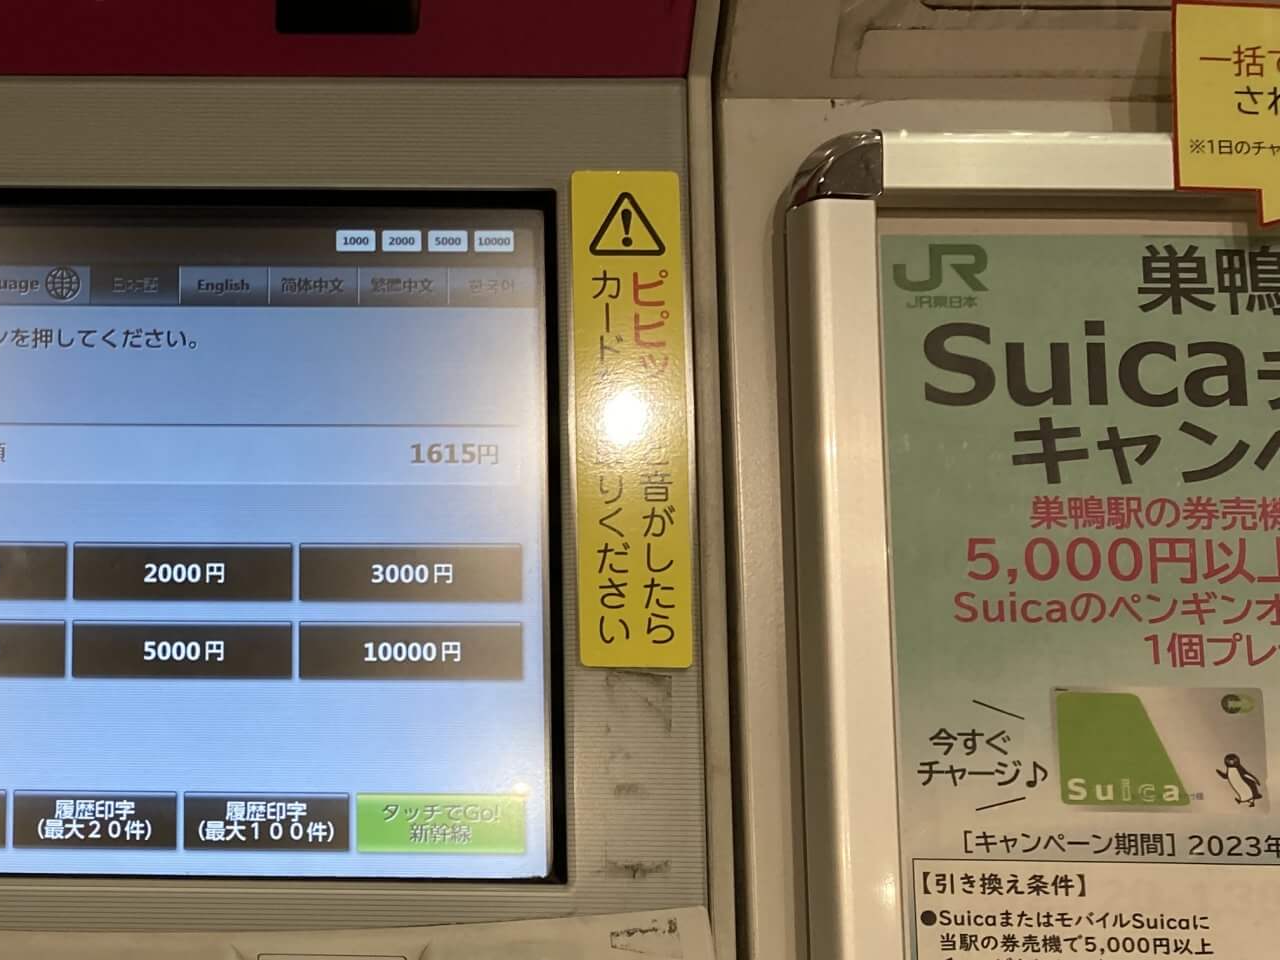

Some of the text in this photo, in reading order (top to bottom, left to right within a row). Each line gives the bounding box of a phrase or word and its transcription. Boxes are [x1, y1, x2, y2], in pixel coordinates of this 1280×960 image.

[342, 236, 511, 247] 1000 2000 5000 10000
[893, 244, 988, 291] JR
[197, 278, 251, 293] English
[281, 276, 344, 294] 简体中文
[906, 295, 978, 308] JR東日本
[410, 443, 499, 466] 1615円
[143, 562, 225, 584] 2000円
[371, 563, 454, 585] 3000円
[143, 640, 225, 662] 5000円
[363, 641, 462, 663] 10000円
[929, 728, 1010, 756] 今すぐ
[1067, 777, 1179, 801] Suica
[54, 799, 135, 820] 履歴印字
[225, 801, 307, 822] 履歴印字
[409, 823, 473, 844] 新幹線
[940, 934, 1214, 956] 当駅の券売機で5,000円以上
